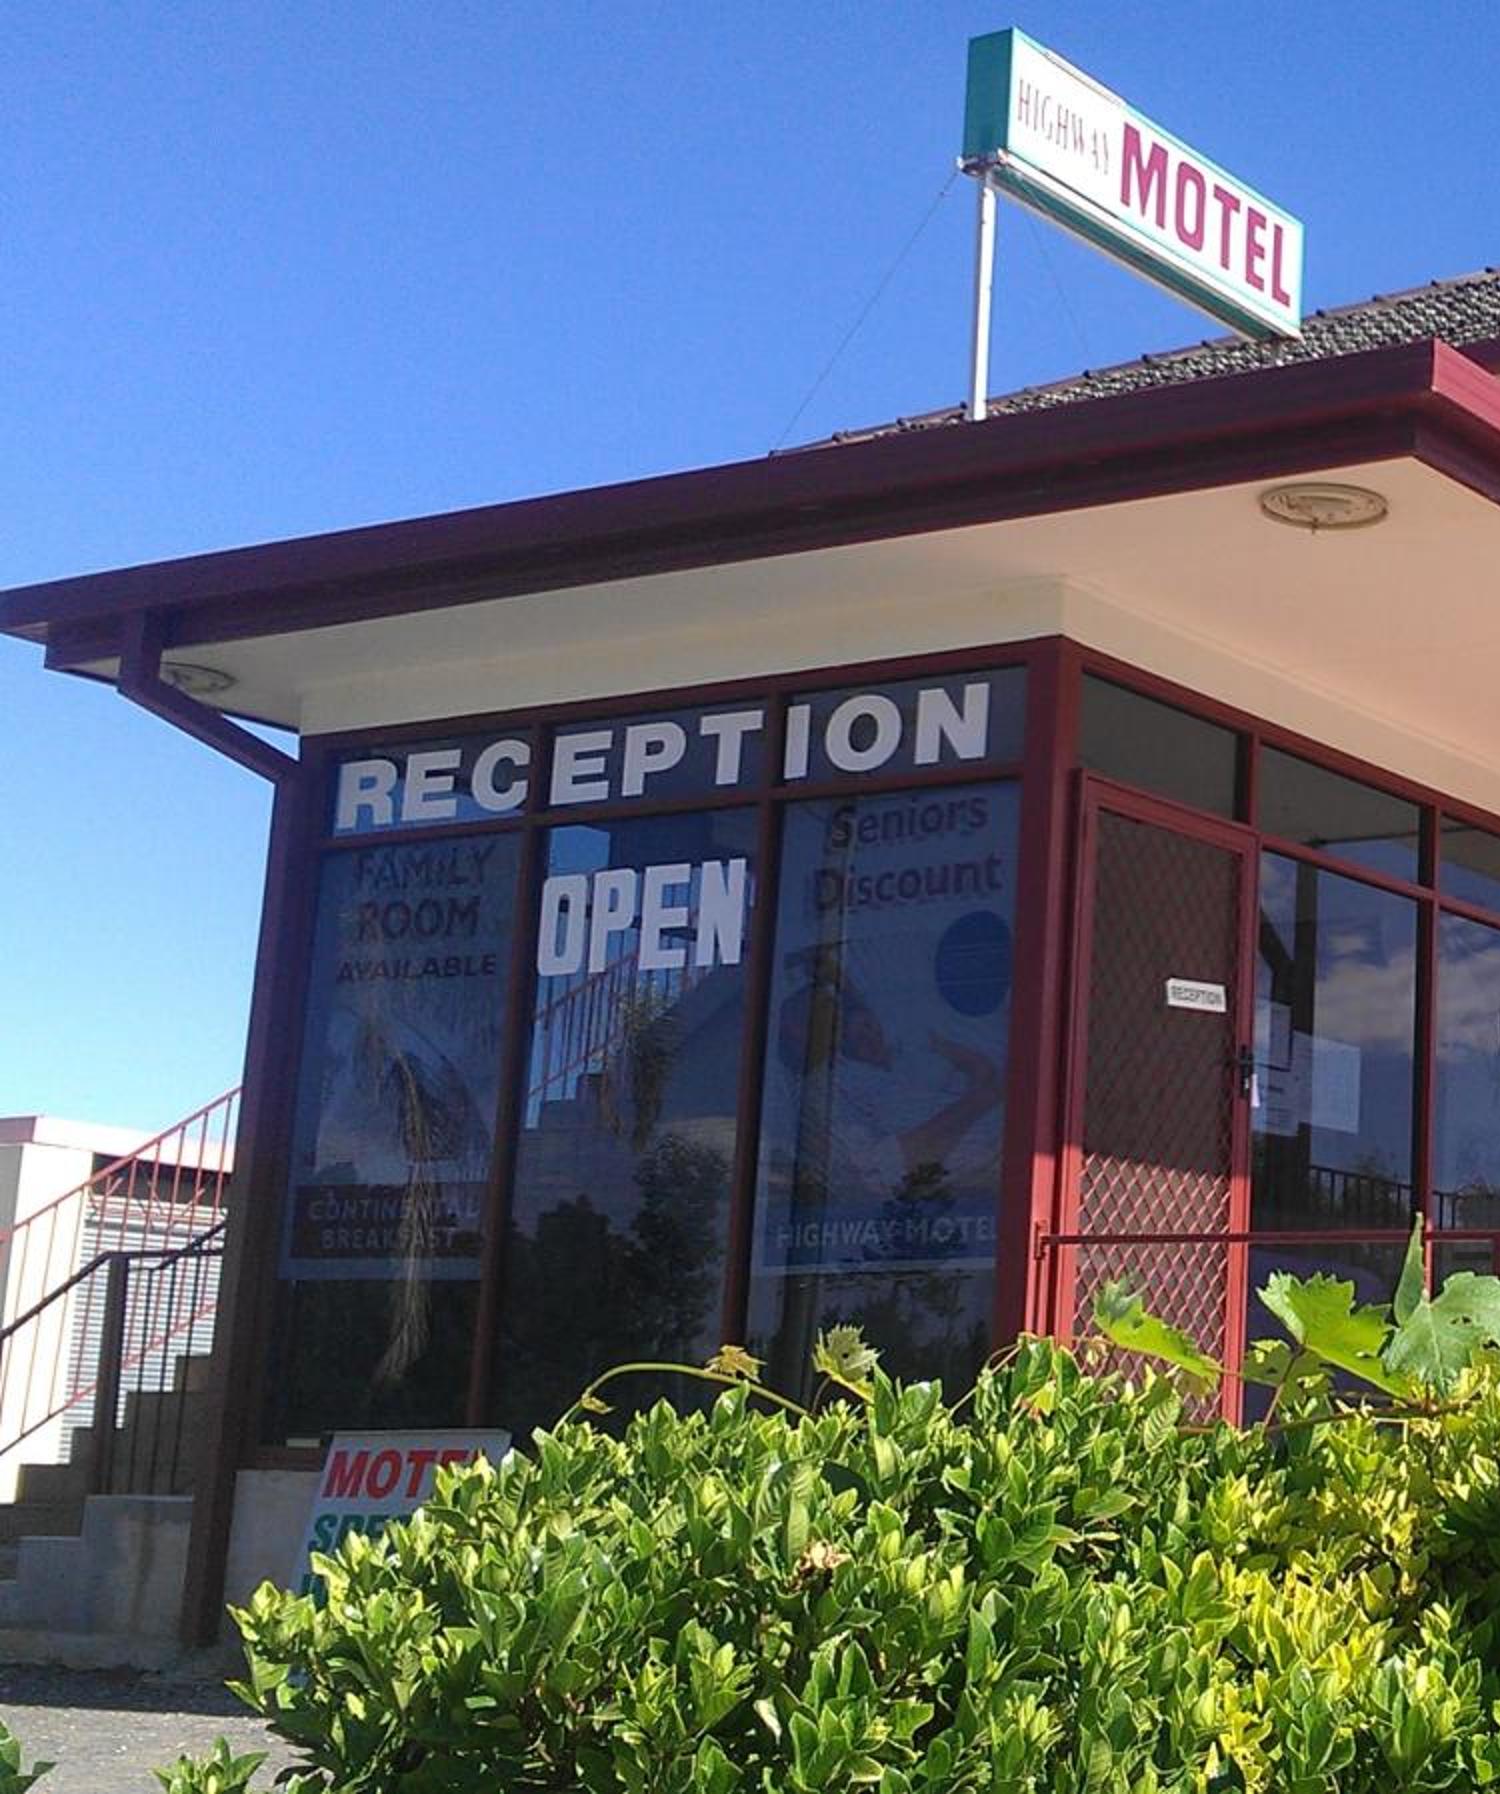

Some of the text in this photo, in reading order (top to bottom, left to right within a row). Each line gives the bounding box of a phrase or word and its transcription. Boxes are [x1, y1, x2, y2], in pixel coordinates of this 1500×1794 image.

[1017, 78, 1291, 308] HIGHWAY MOTEL
[335, 682, 992, 831] RECEPTION
[831, 796, 989, 847] Seniors
[355, 842, 497, 889] FAMILY
[814, 852, 1002, 910] Discount
[359, 896, 480, 942] ROOM
[537, 858, 747, 977] OPEN
[336, 954, 497, 984] AVAILABLE
[1170, 985, 1222, 1005] RECEPTION
[321, 1226, 454, 1249] BREAKFAST
[776, 1218, 896, 1249] HIGHWAY
